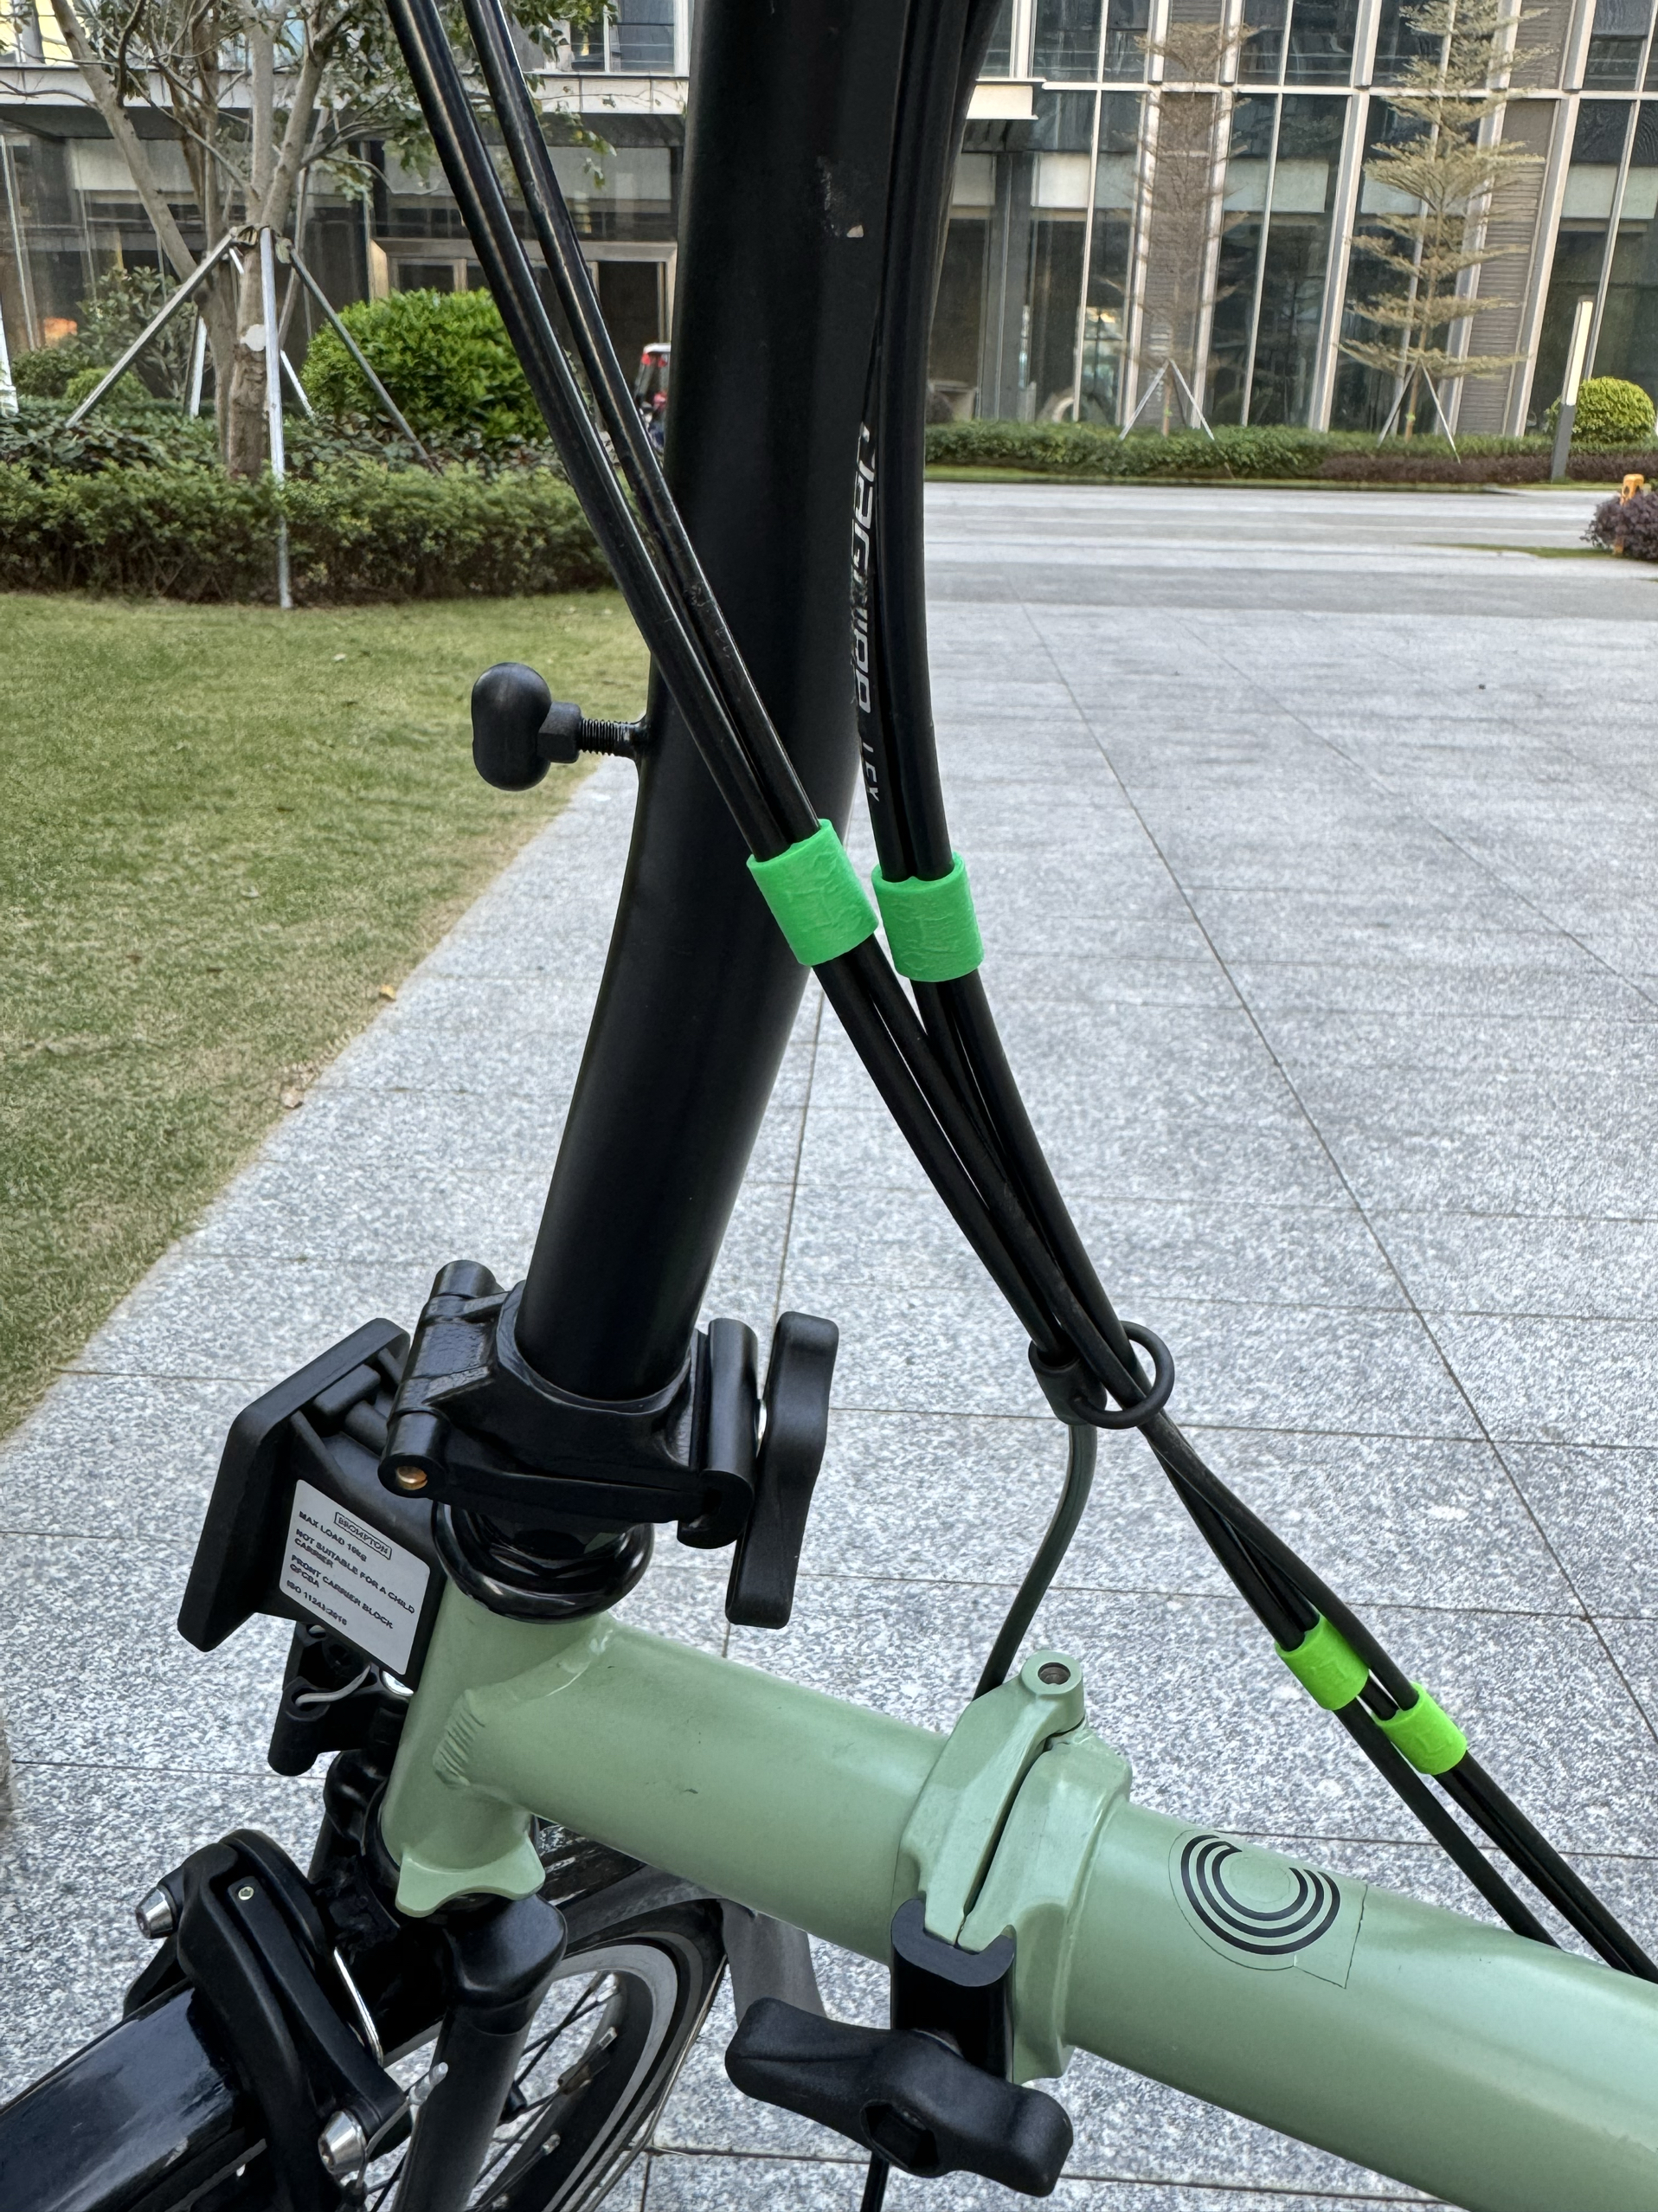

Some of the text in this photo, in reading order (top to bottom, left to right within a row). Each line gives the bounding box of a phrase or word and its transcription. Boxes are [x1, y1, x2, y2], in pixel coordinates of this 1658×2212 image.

[299, 1510, 318, 1528] MAX
[320, 1525, 345, 1546] LOAD
[294, 1538, 333, 1568] CARRIER
[286, 1579, 302, 1594] ISO
[296, 1528, 415, 1615] NOT SUITABLE FOR A CHILD
[291, 1554, 394, 1630] FRONT CARRIER BLOCK
